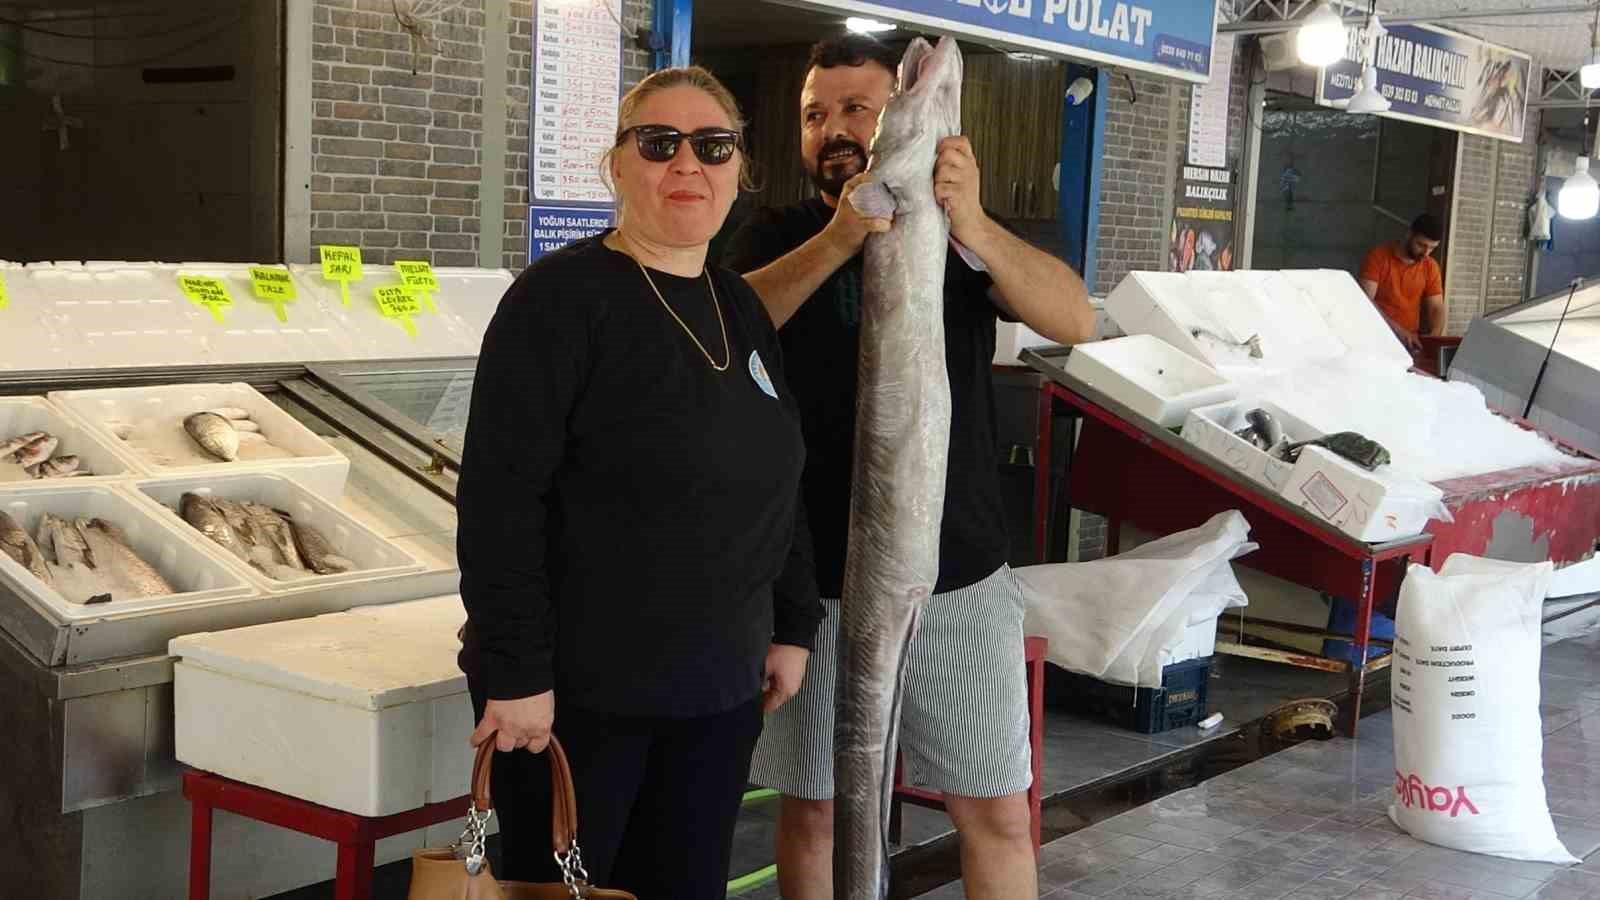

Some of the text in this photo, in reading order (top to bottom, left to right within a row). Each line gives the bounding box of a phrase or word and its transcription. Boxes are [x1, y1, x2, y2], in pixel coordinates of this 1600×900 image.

[1043, 0, 1152, 46] POLAT
[1412, 43, 1469, 91] BALIKÇILIK
[534, 229, 556, 239] BALIK
[538, 215, 565, 227] YOĞUN
